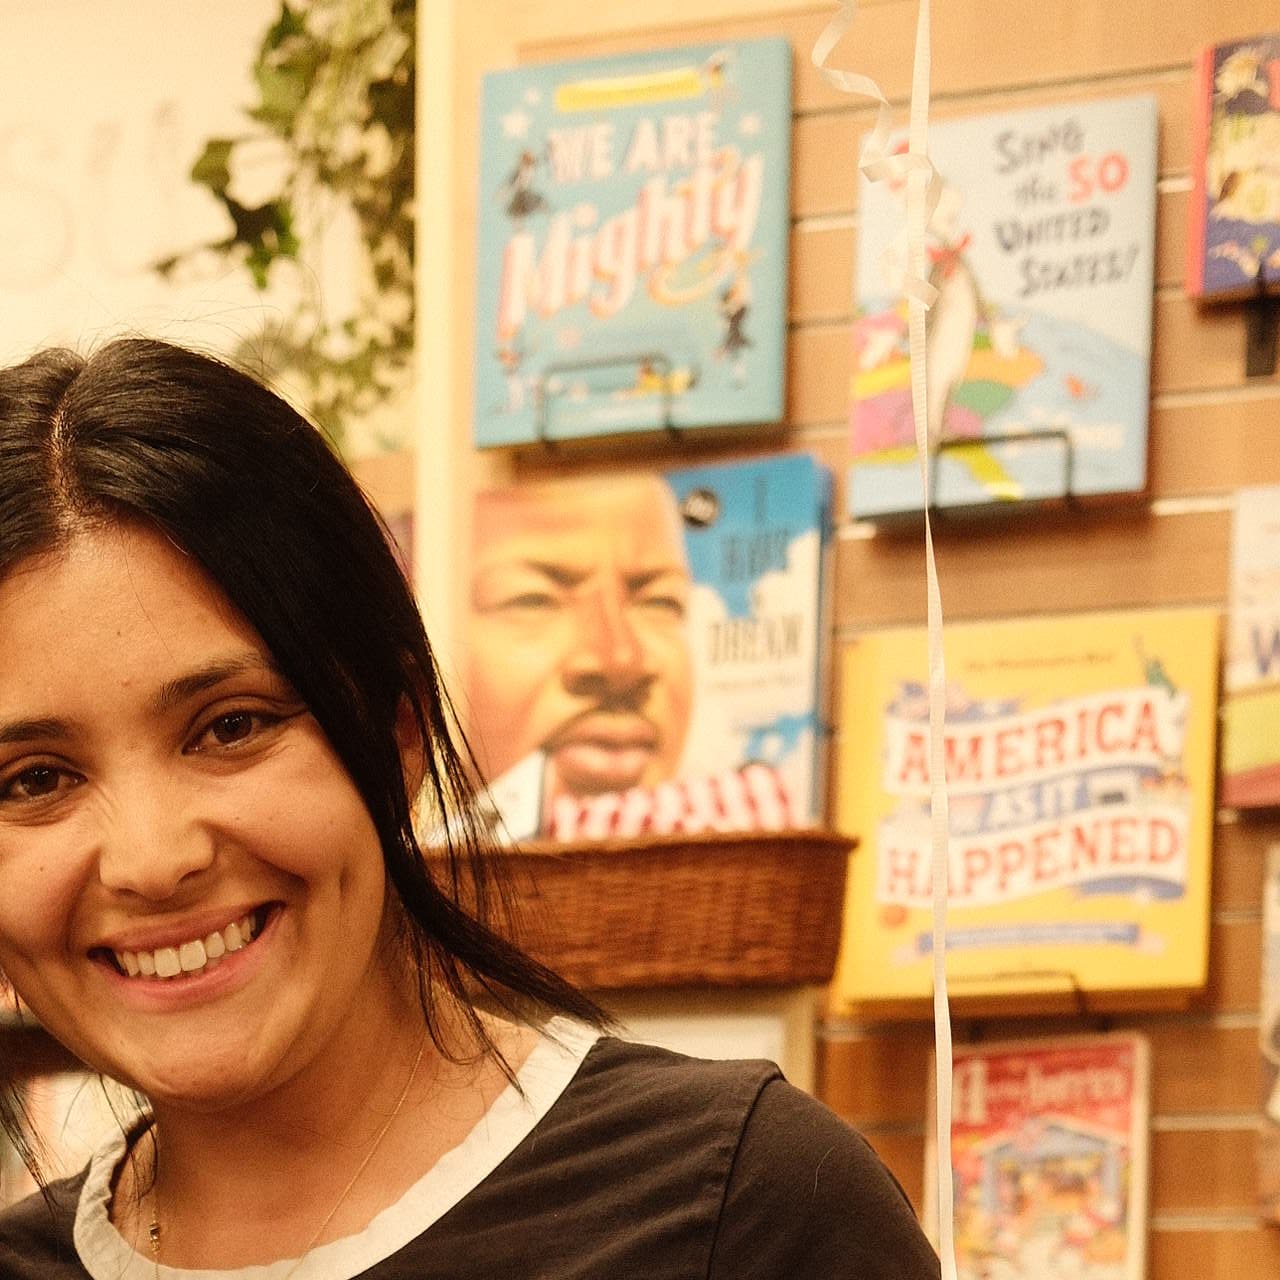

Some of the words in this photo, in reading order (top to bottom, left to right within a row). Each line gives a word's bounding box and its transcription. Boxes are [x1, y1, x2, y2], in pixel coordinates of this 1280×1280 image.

[546, 122, 614, 183] WE
[625, 110, 718, 174] ARE
[1066, 150, 1130, 205] SO
[496, 145, 765, 342] Mighty
[992, 207, 1111, 252] UNITED
[898, 699, 1165, 786] AMERICA
